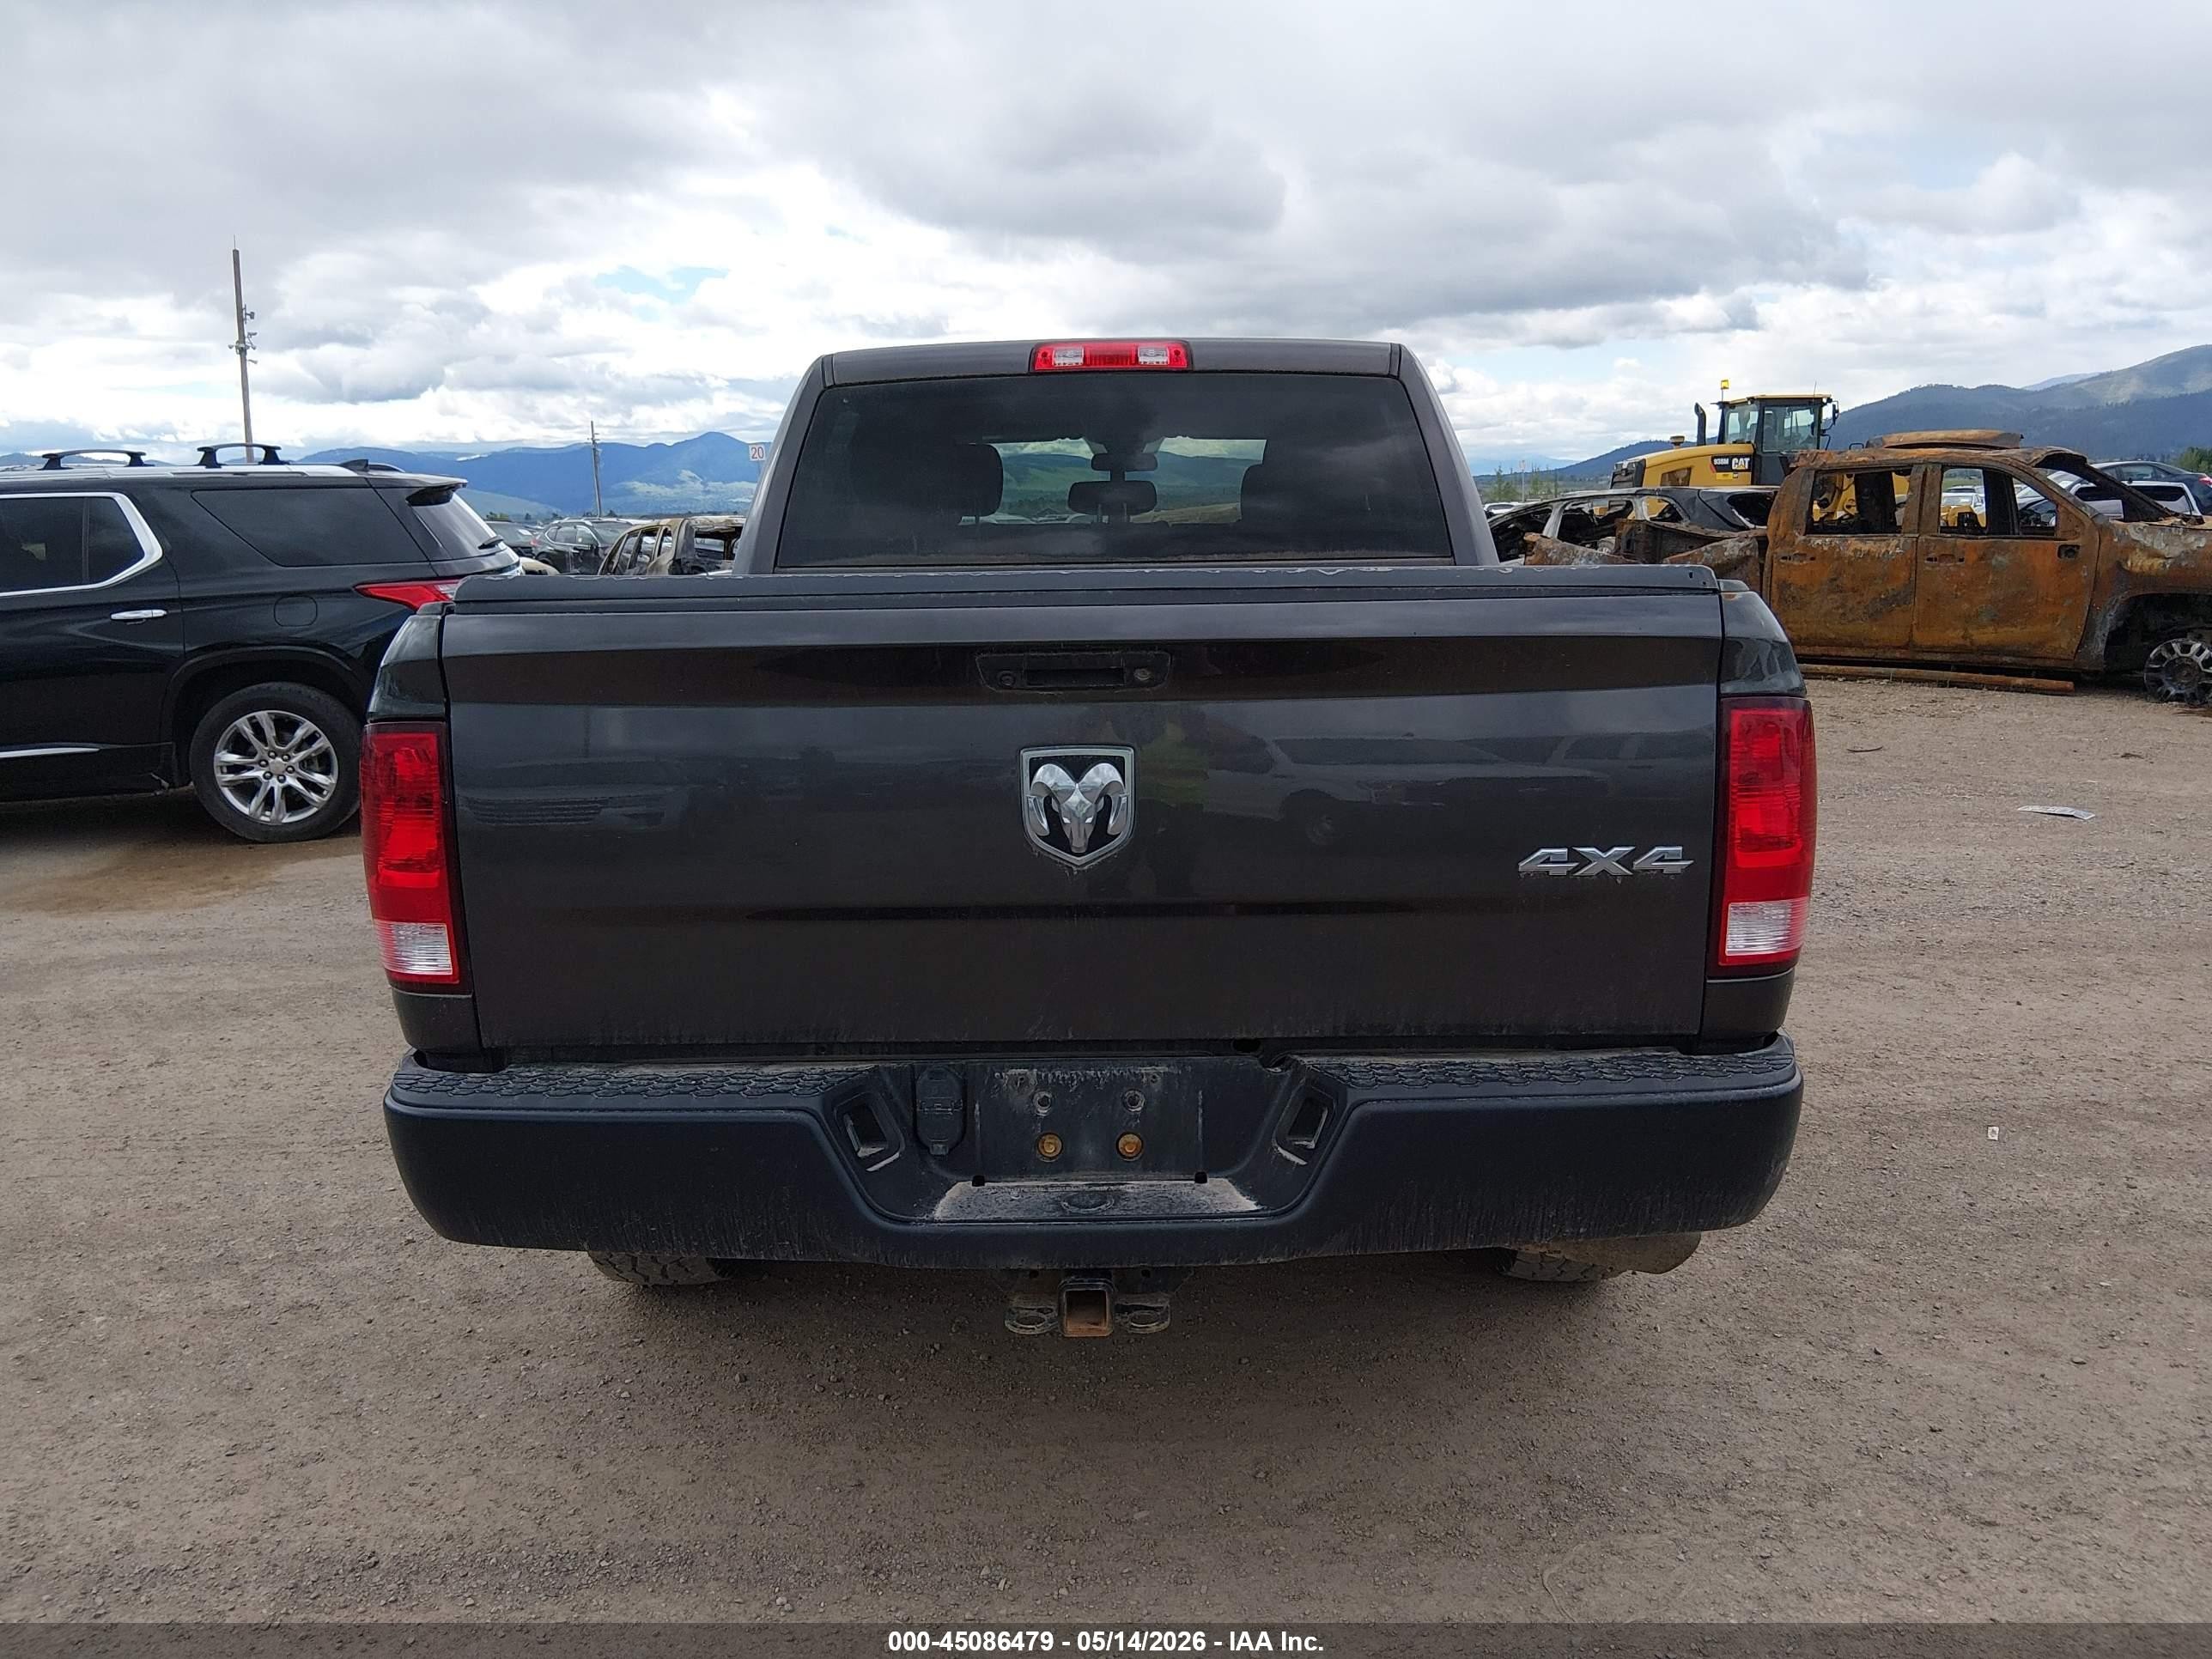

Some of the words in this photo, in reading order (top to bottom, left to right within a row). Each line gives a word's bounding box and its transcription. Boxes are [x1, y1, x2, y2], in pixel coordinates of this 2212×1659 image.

[750, 447, 764, 459] 20
[1731, 458, 1750, 471] CAT
[1518, 846, 1694, 876] 4X4
